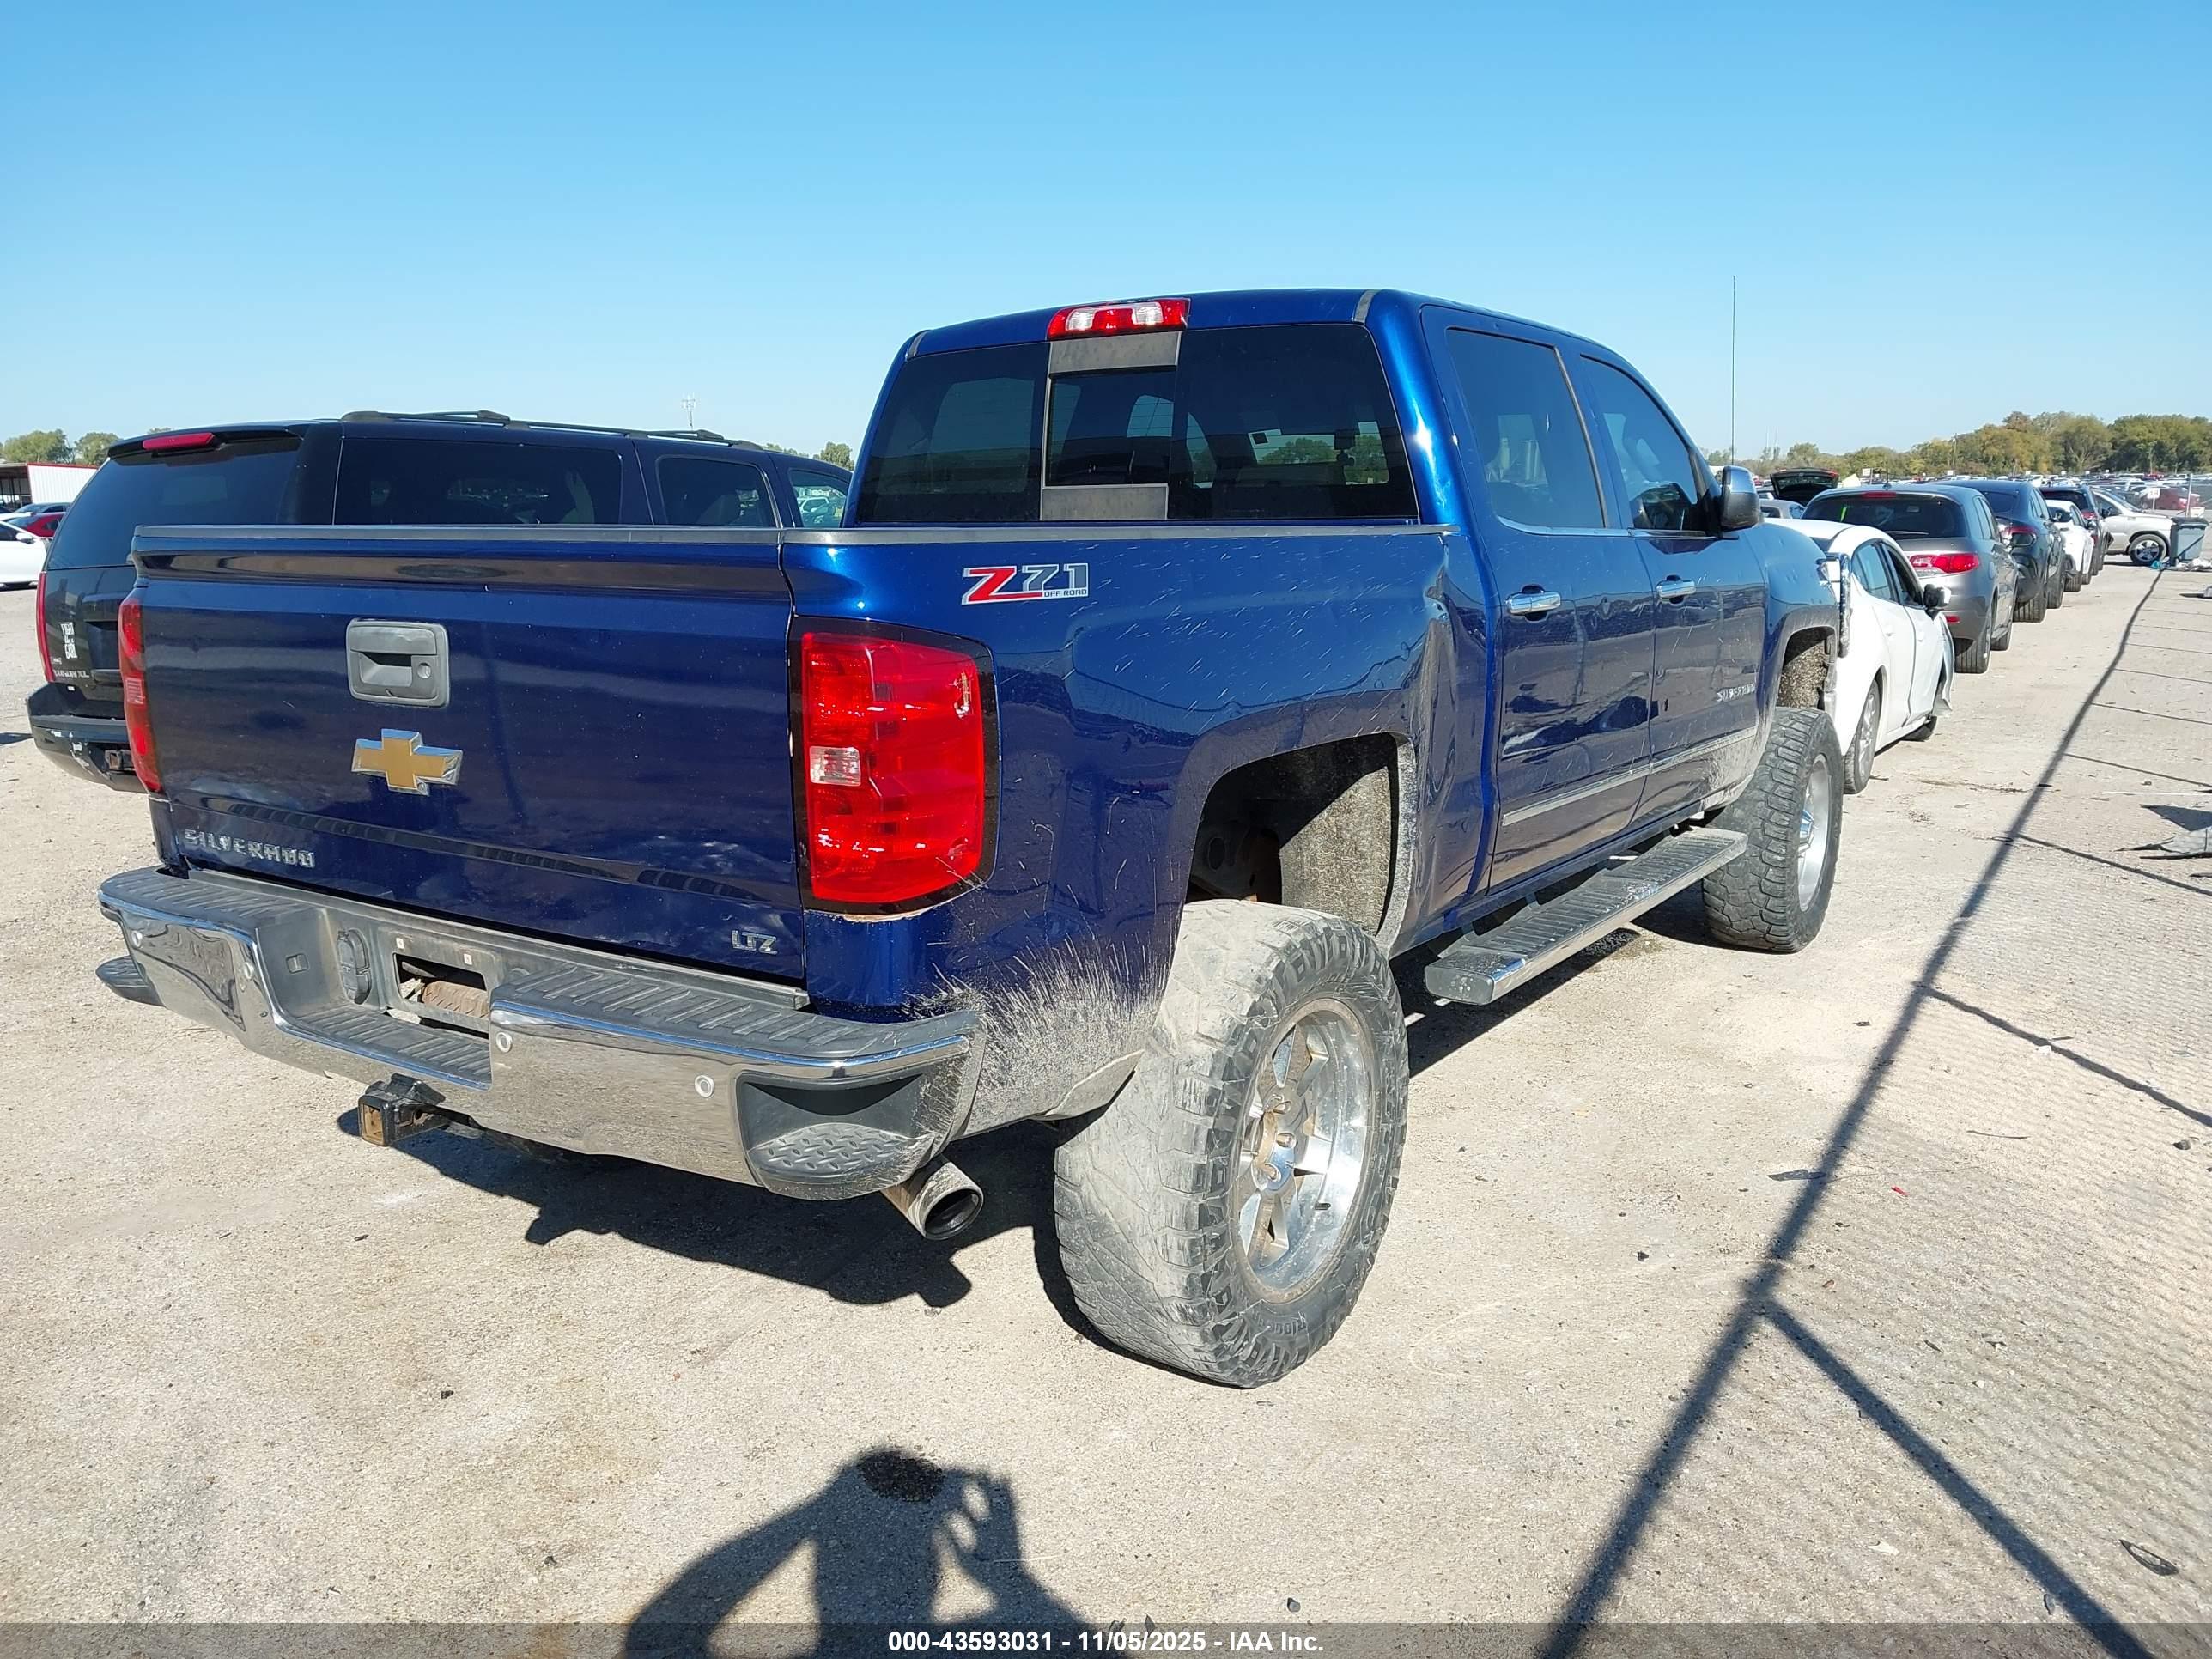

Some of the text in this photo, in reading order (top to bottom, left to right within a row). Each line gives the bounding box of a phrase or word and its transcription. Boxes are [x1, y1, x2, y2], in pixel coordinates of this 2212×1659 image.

[962, 563, 1088, 605] Z71
[1063, 588, 1087, 597] ROAD
[184, 829, 316, 869] SILVERADO
[732, 930, 778, 955] LTZ
